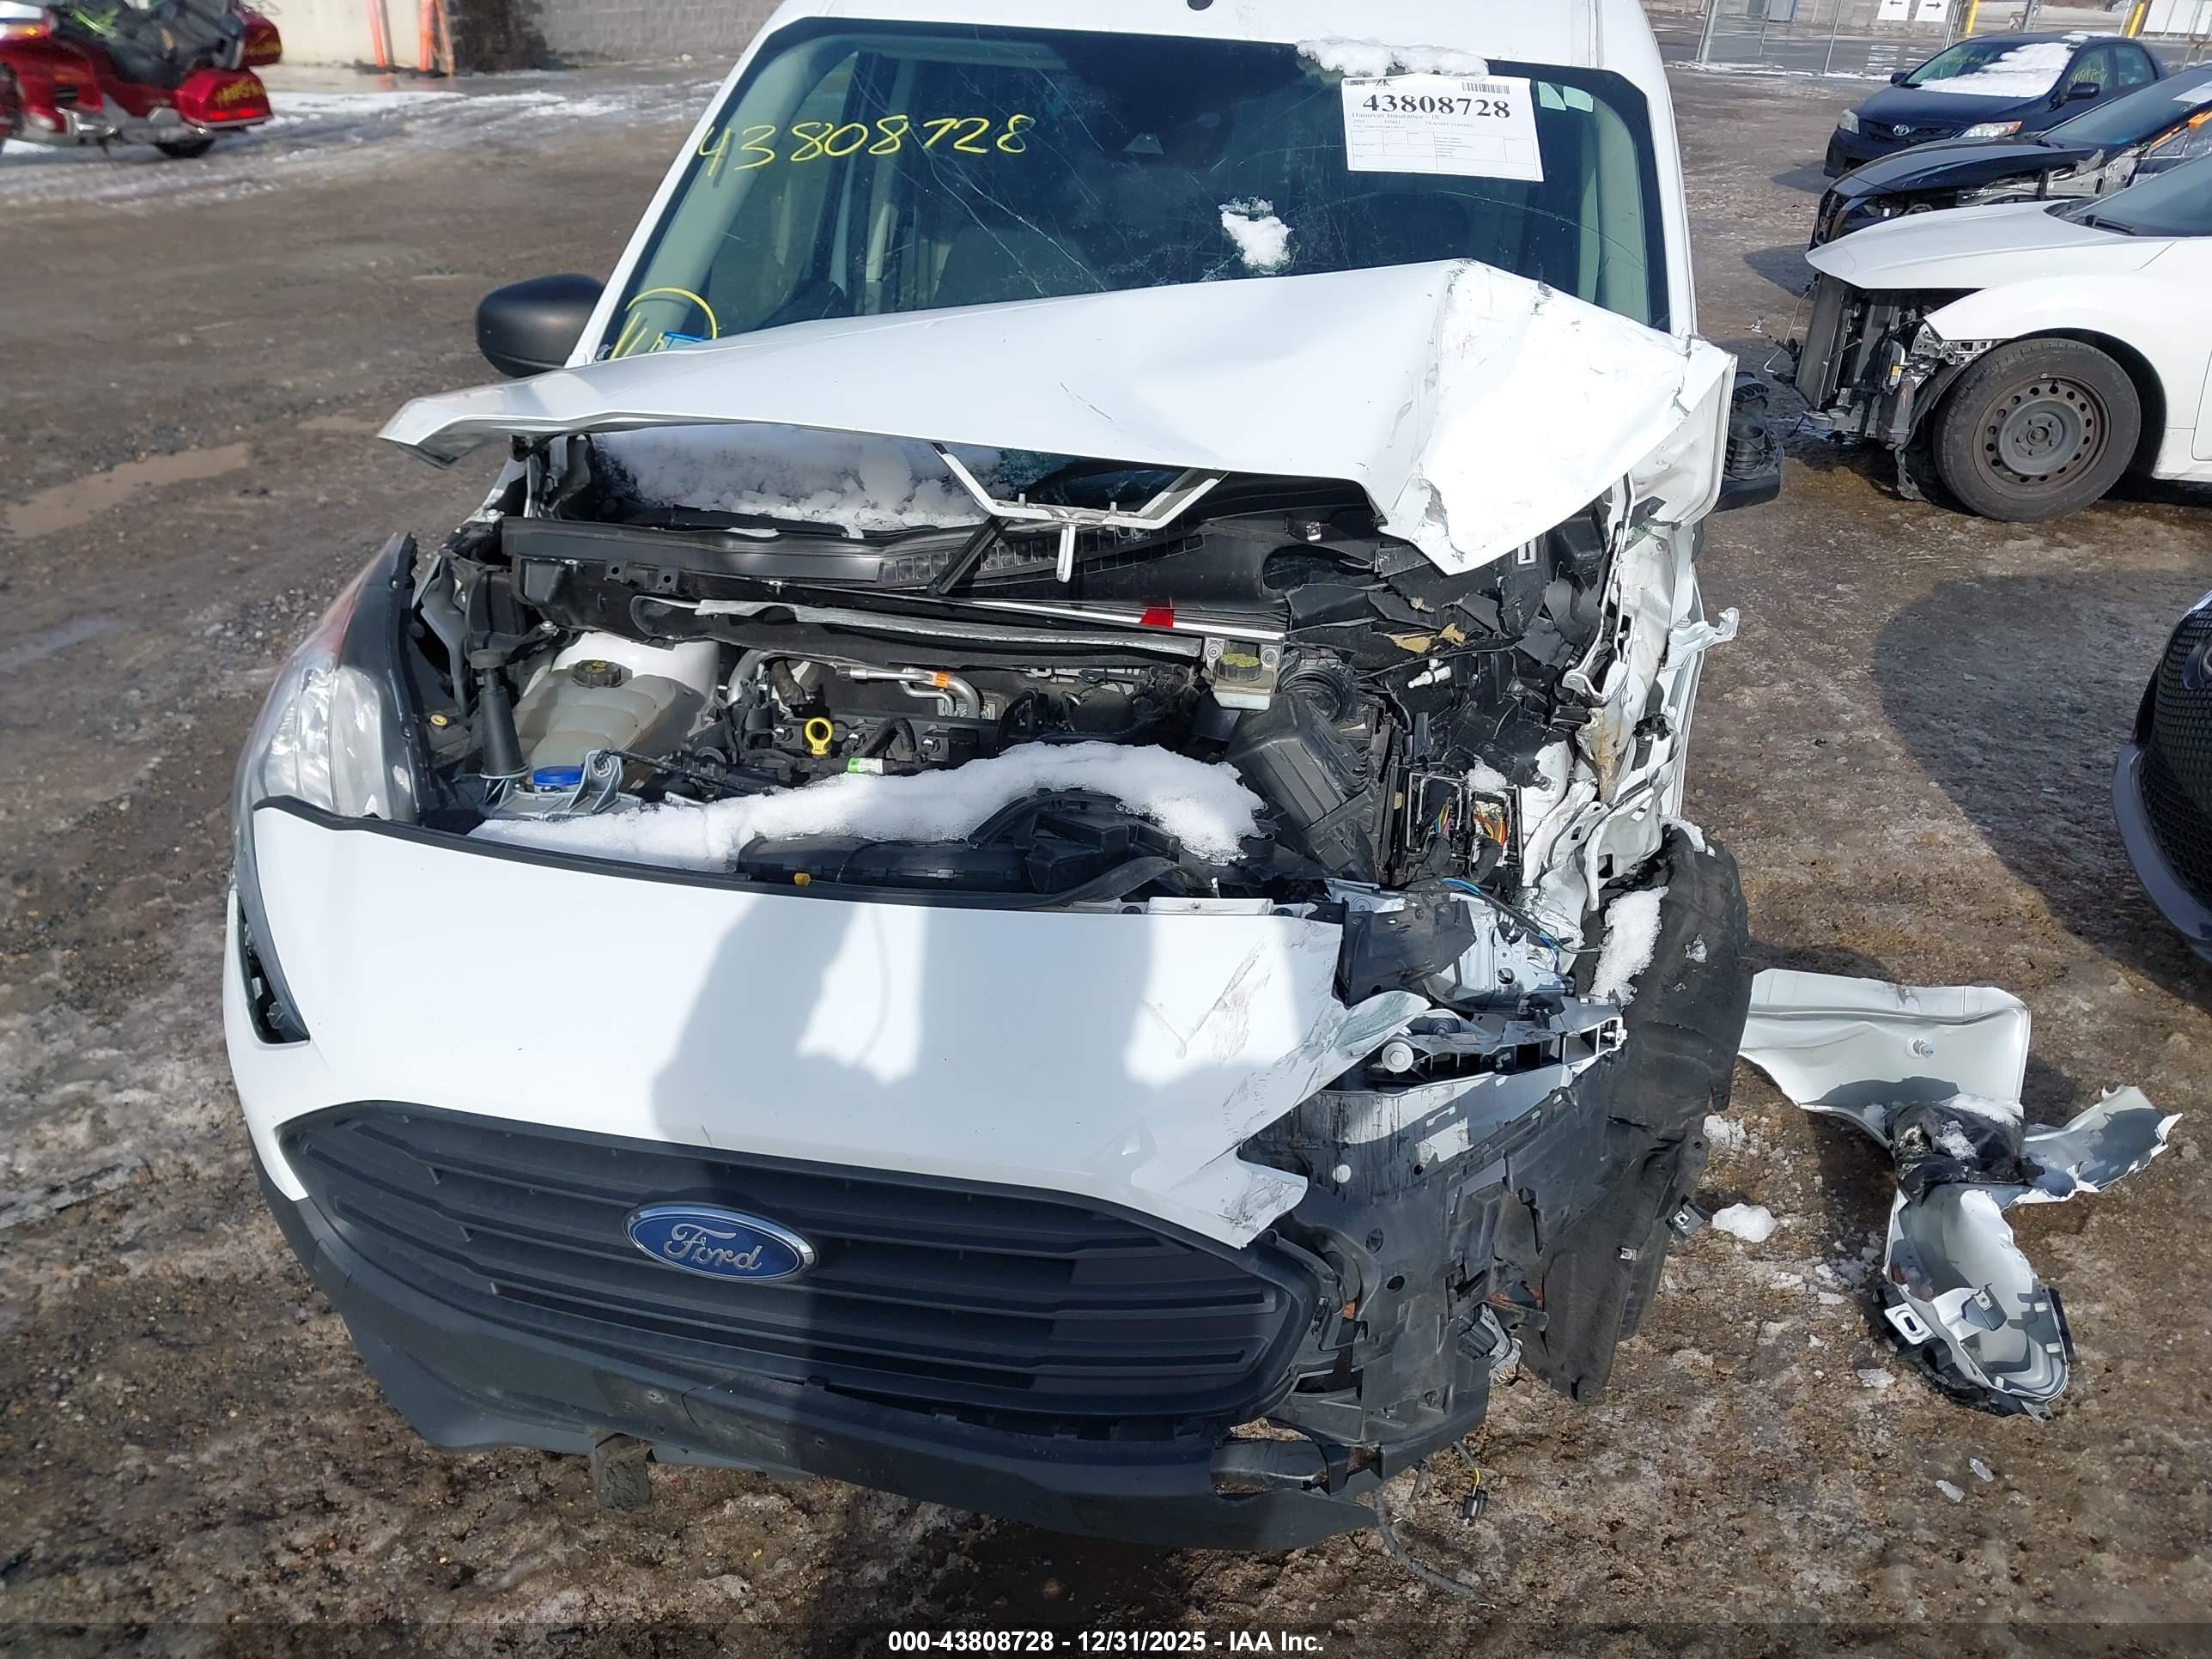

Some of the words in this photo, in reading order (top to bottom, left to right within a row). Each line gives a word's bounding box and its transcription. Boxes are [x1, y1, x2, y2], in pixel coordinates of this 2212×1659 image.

[1362, 94, 1510, 118] 43808728
[698, 114, 1035, 177] 43808728
[663, 1223, 763, 1272] Ford
